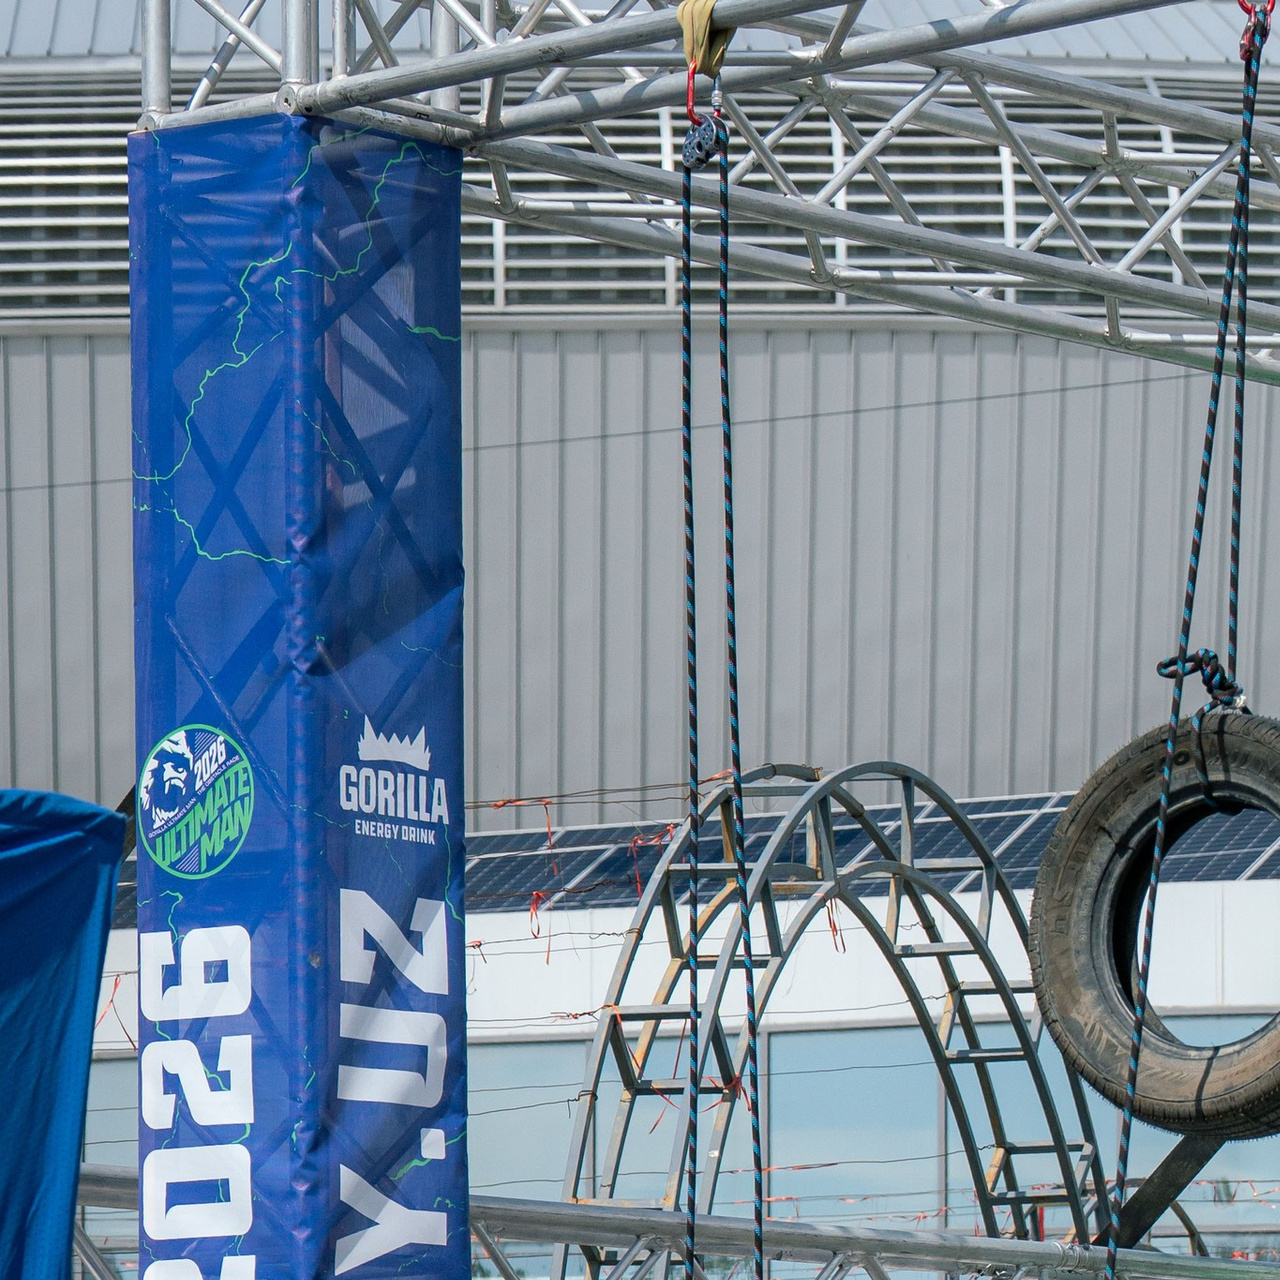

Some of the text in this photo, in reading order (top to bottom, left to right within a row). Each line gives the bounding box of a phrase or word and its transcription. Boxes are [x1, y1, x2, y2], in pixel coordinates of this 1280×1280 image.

[194, 735, 228, 792] 2026
[154, 766, 250, 868] ULTIMATE
[339, 764, 449, 826] GORILLA
[200, 796, 251, 873] MAN
[354, 818, 436, 847] ENERGY DRINK
